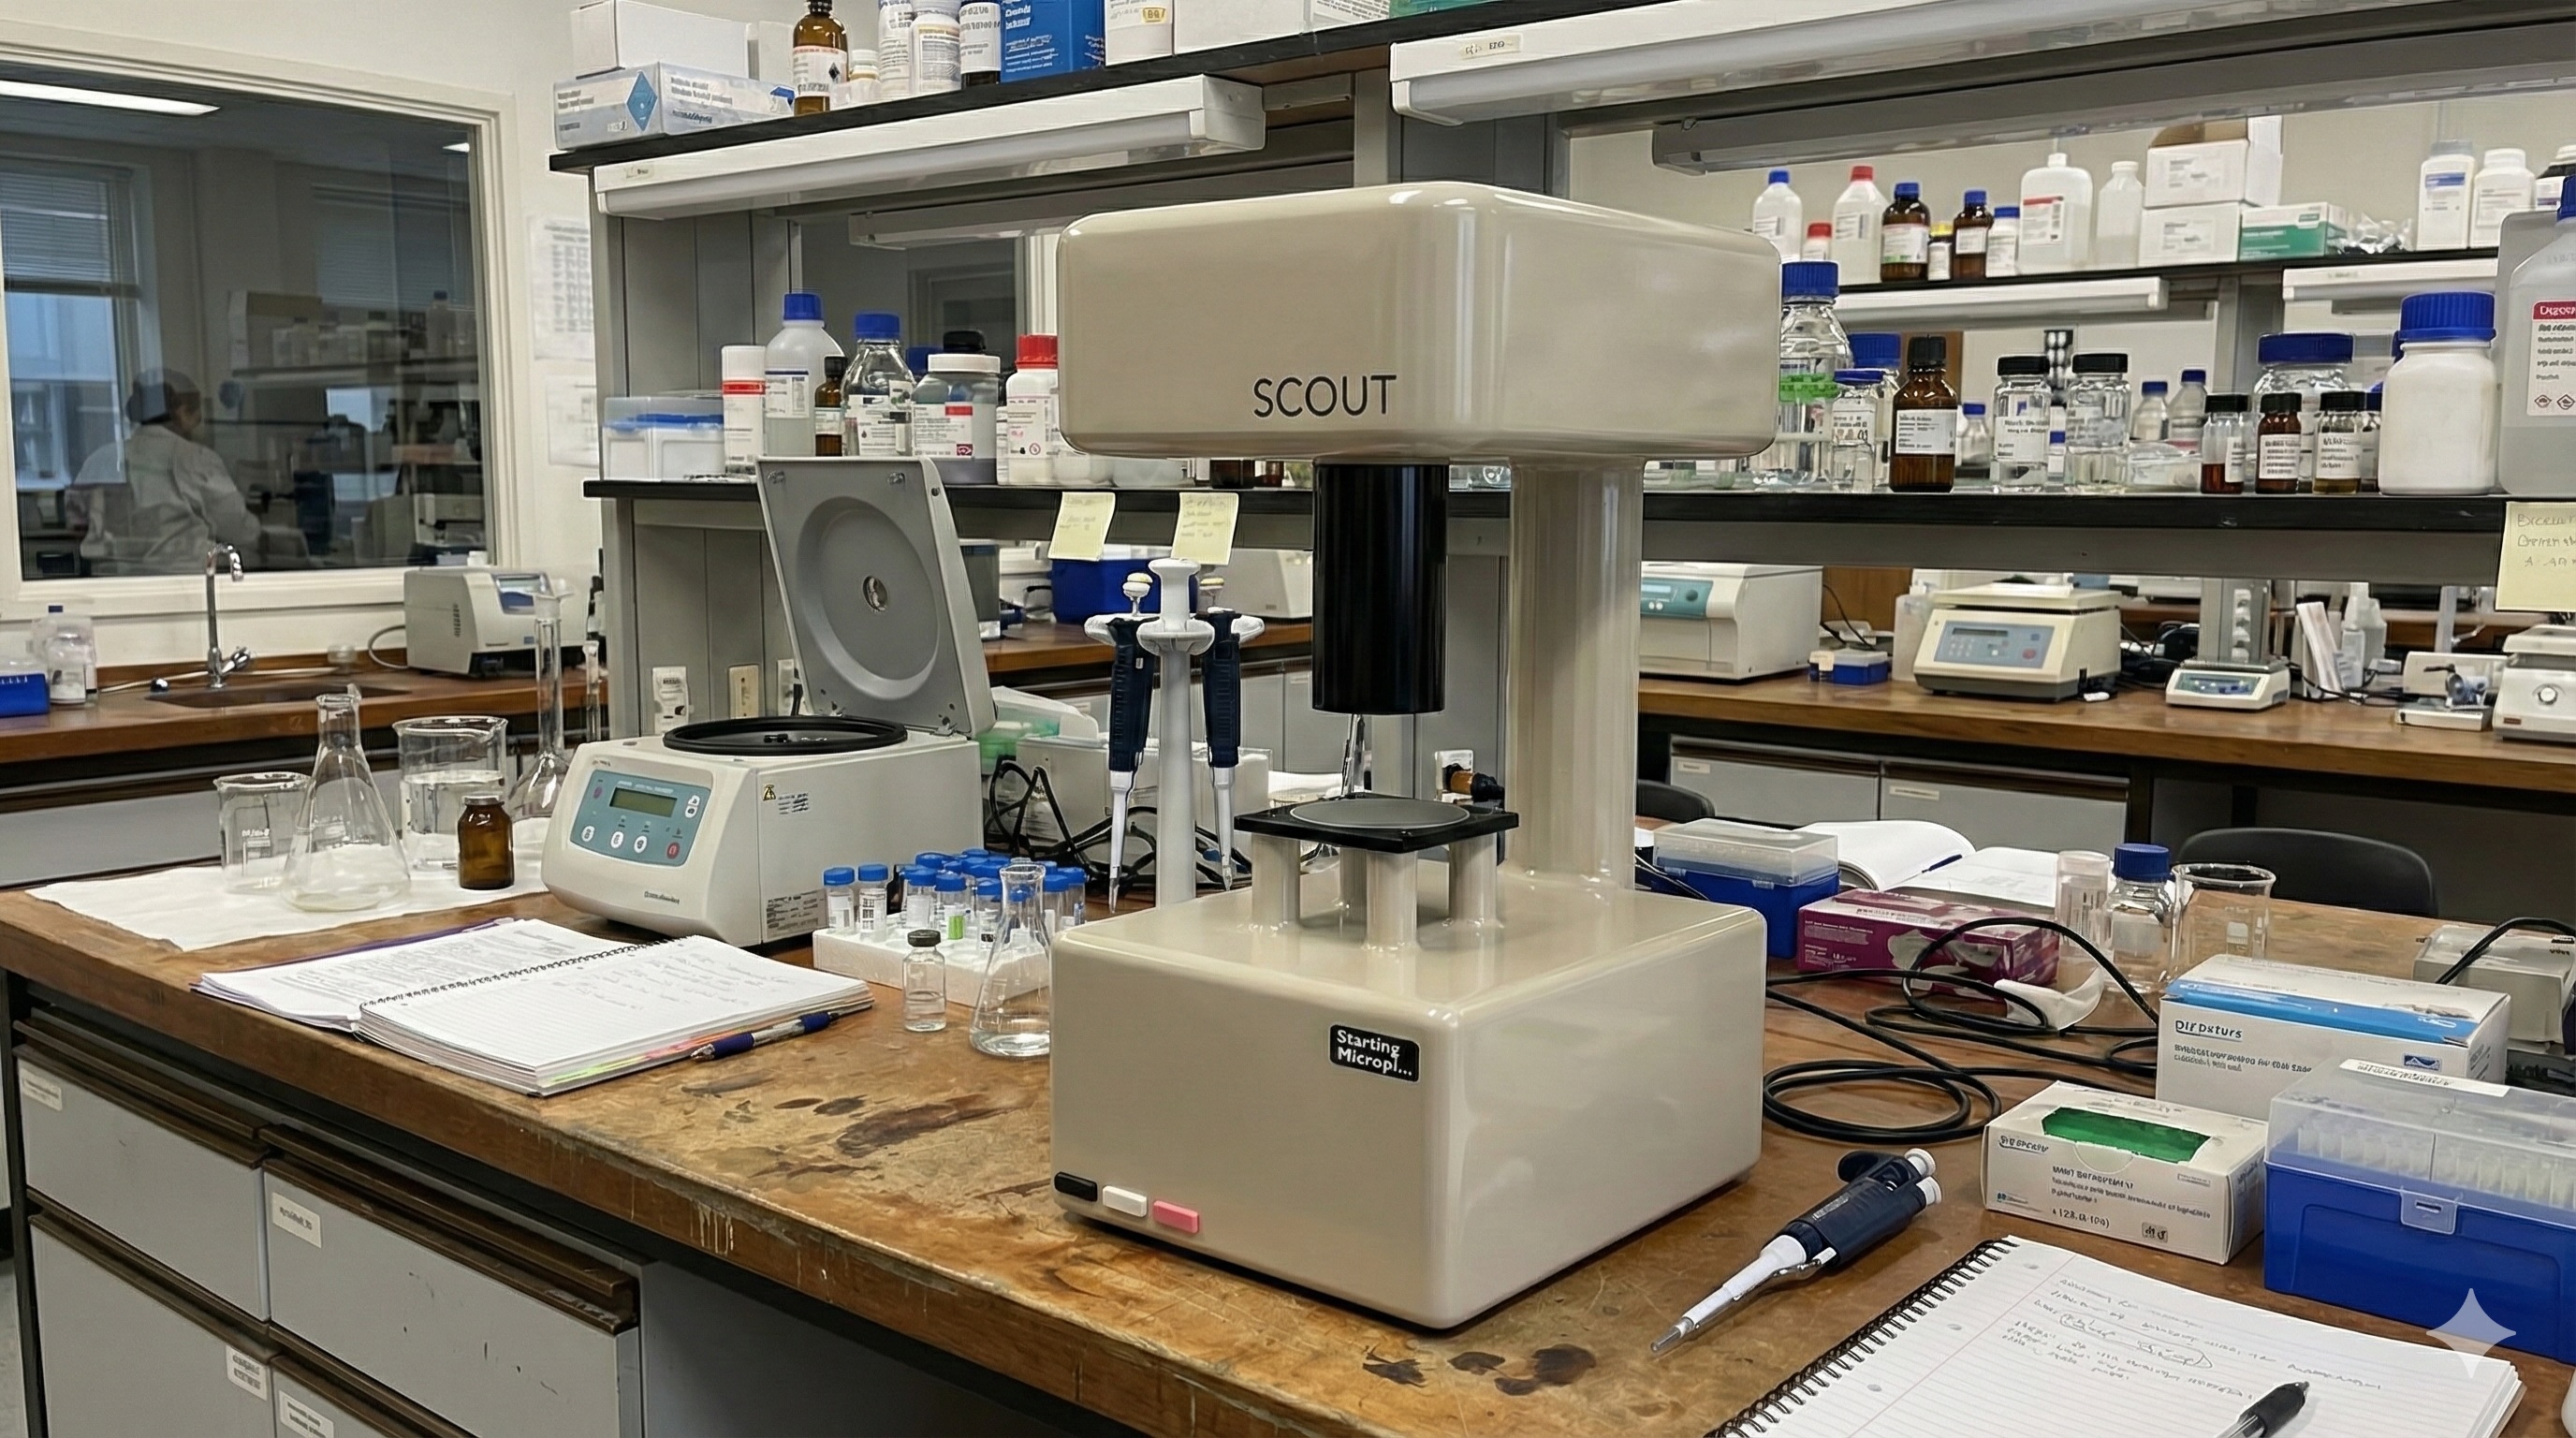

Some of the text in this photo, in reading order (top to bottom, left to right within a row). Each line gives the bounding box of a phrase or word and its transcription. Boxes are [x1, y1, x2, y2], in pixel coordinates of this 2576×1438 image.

[1253, 374, 1398, 418] SCOUT
[1337, 1029, 1400, 1059] Starting
[1337, 1046, 1412, 1075] Micropl...
